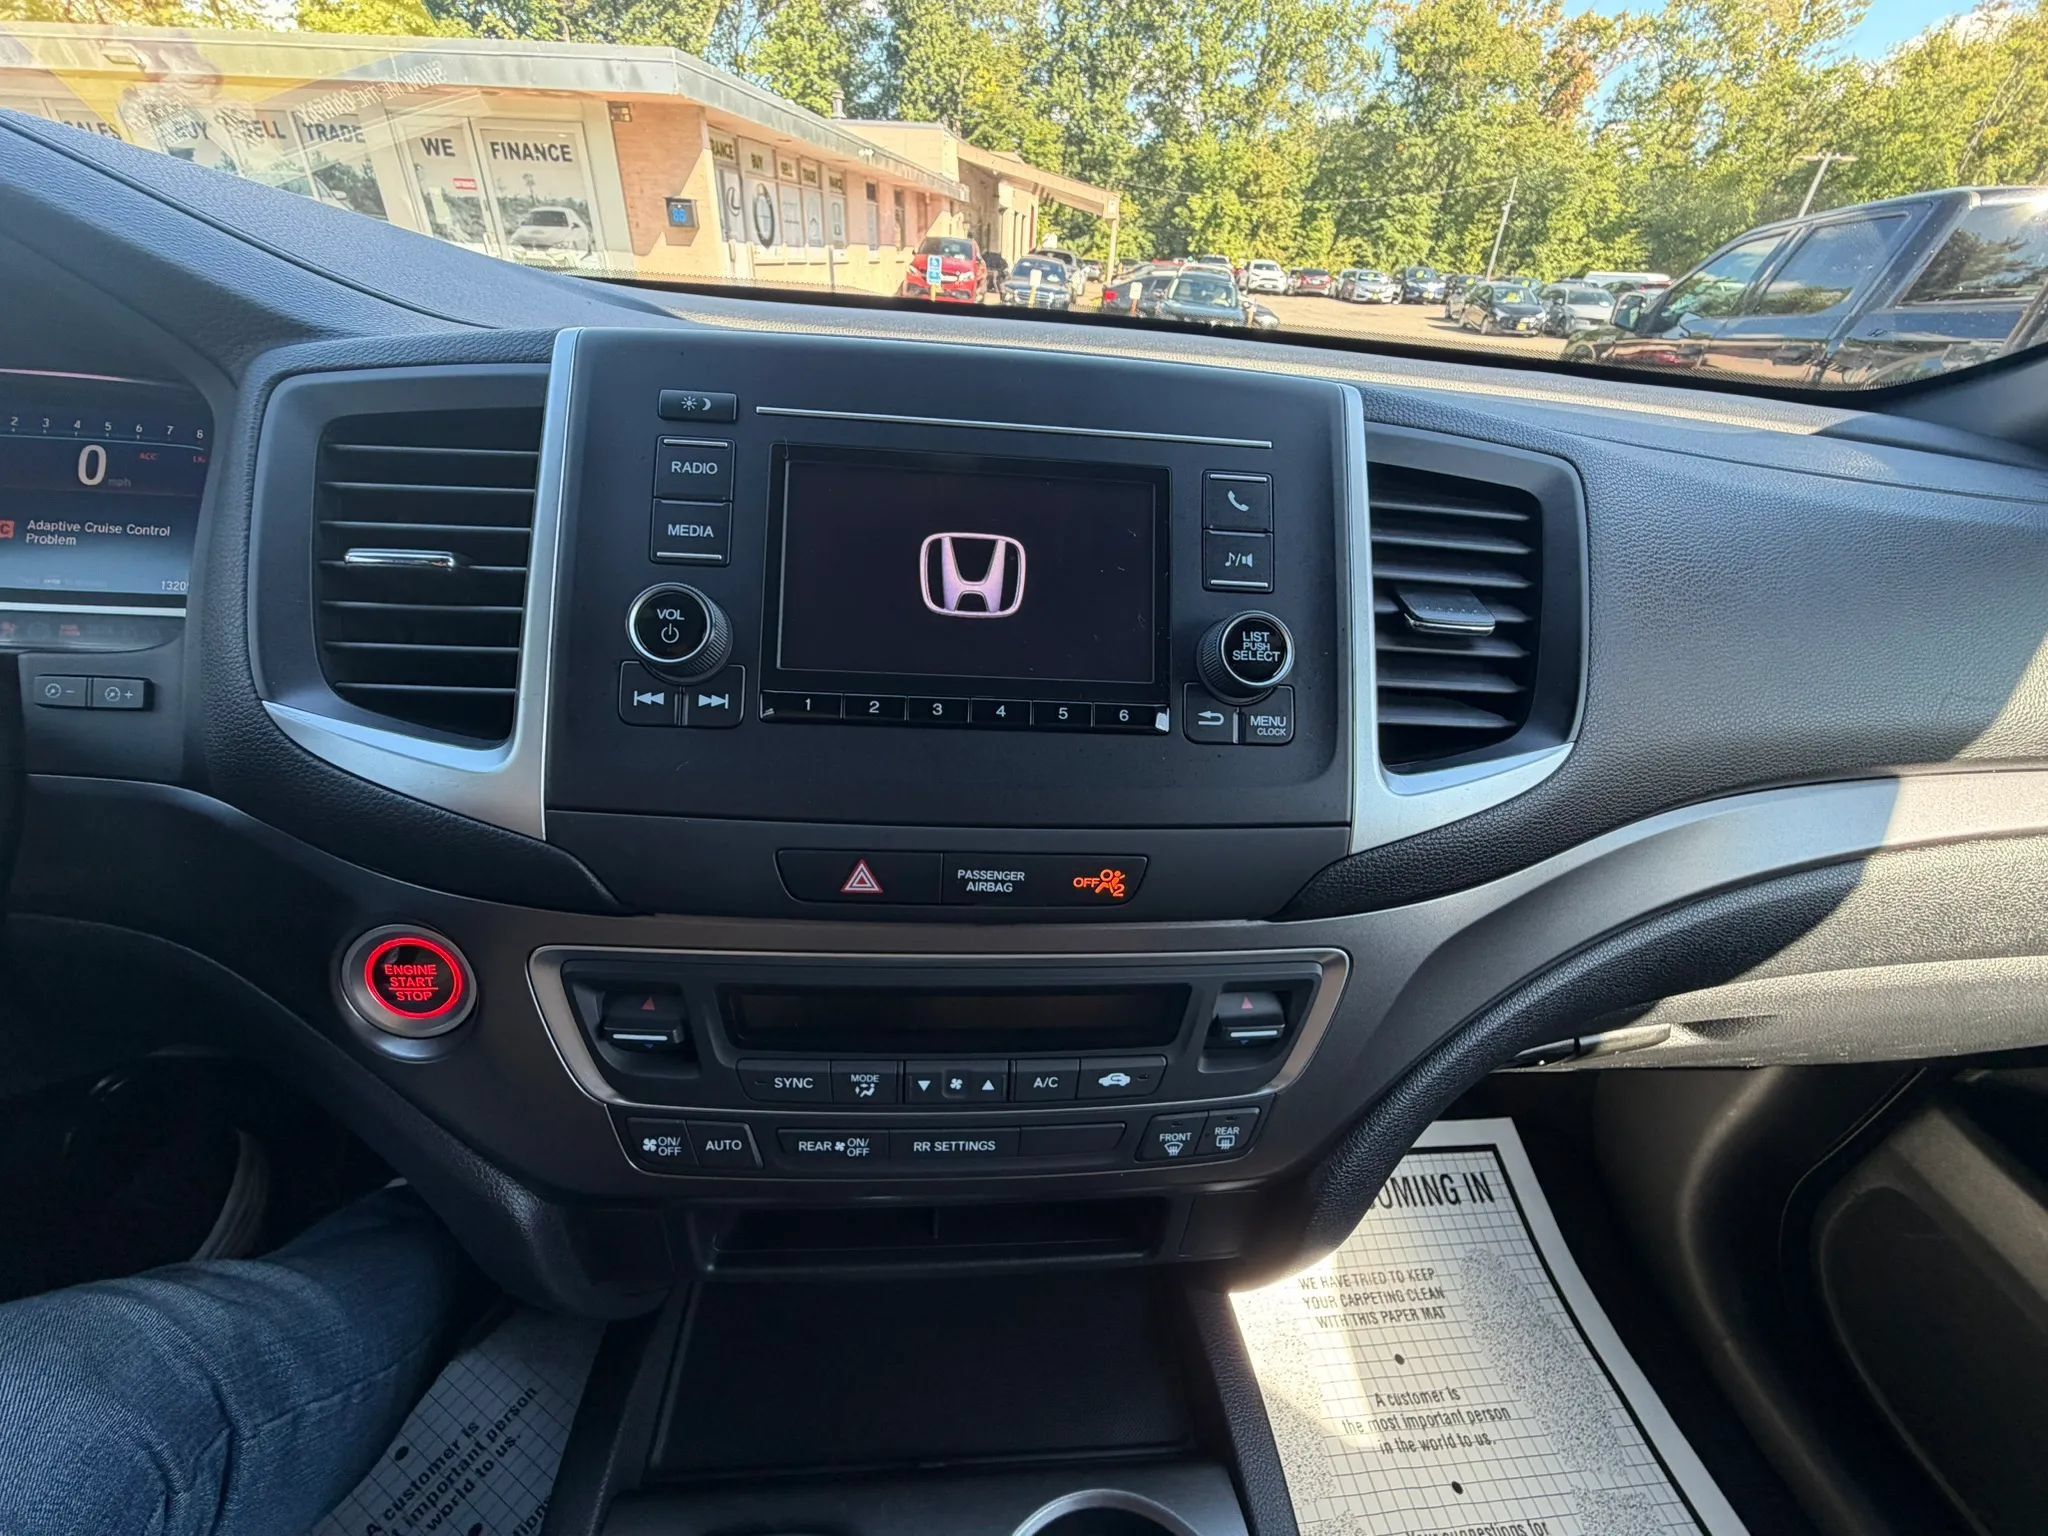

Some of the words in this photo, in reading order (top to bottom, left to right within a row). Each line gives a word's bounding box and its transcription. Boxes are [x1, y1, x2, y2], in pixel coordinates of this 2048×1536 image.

[303, 122, 366, 144] TRADE
[420, 137, 456, 157] WE
[489, 141, 574, 163] FINANCE
[11, 416, 18, 427] 2
[42, 418, 50, 428] 3
[73, 419, 81, 429] 4
[104, 421, 112, 432] 5
[135, 423, 143, 433] 6
[166, 425, 174, 436] 7
[196, 429, 204, 439] 8
[77, 444, 108, 486] 0
[108, 475, 132, 488] mph
[671, 460, 718, 476] RADIO
[27, 519, 81, 534] Adaptive
[85, 522, 122, 535] Cruise
[126, 523, 171, 537] Control
[667, 523, 714, 539] MEDIA
[25, 533, 77, 546] Problem
[160, 580, 189, 592] 1320
[656, 608, 685, 621] VOL
[1242, 631, 1270, 643] LIST
[1243, 642, 1270, 651] PUSH
[1232, 650, 1280, 662] SELECT
[805, 698, 811, 711] 1
[869, 701, 880, 714] 2
[932, 703, 943, 716] 3
[995, 705, 1006, 718] 4
[1058, 707, 1068, 720] 5
[1119, 709, 1129, 722] 6
[1250, 715, 1287, 727] MENU
[1257, 727, 1286, 736] CLOCK
[957, 869, 1025, 882] PASSENGER
[966, 881, 1013, 894] AIRBAG
[1073, 876, 1100, 889] OFF
[384, 963, 438, 976] ENGINE
[389, 977, 434, 987] START
[395, 991, 433, 1001] STOP
[774, 1077, 814, 1089] SYNC
[850, 1074, 880, 1083] MODE
[1033, 1076, 1058, 1089] A/C
[1159, 1131, 1192, 1143] FRONT
[1214, 1126, 1240, 1136] REAR
[658, 1136, 682, 1147] ON/
[705, 1140, 742, 1151] AUTO
[798, 1141, 832, 1151] REAR
[847, 1137, 870, 1148] ON/
[913, 1140, 931, 1152] RR
[934, 1141, 996, 1152] SETTINGS
[658, 1146, 682, 1157] OFF
[847, 1147, 870, 1158] OFF
[1370, 1172, 1462, 1210] OMING
[1462, 1171, 1496, 1204] IN
[1298, 1277, 1318, 1290] WE
[1319, 1274, 1351, 1289] HAVE
[1351, 1271, 1387, 1287] TRIED
[1388, 1269, 1406, 1284] TO
[1406, 1267, 1435, 1282] KEEP
[1302, 1294, 1339, 1310] YOUR
[1339, 1289, 1405, 1308] CARPETING
[1406, 1286, 1446, 1302] CLEAN
[1316, 1313, 1349, 1329] WITH
[1350, 1311, 1379, 1327] THIS
[1380, 1308, 1420, 1324] PAPER
[1420, 1305, 1447, 1320] MAT
[1374, 1393, 1385, 1408] A
[1386, 1390, 1445, 1408] customer
[1446, 1386, 1461, 1401] is
[1342, 1418, 1364, 1435] the
[1369, 1413, 1401, 1432] most
[1402, 1408, 1466, 1432] important
[1466, 1406, 1511, 1426] person
[1378, 1439, 1394, 1455] in
[1395, 1436, 1417, 1453] the
[1418, 1433, 1457, 1452] world
[1457, 1431, 1473, 1447] to
[1475, 1432, 1497, 1446] us.
[406, 1441, 488, 1528] important
[486, 1386, 538, 1443] person
[383, 1438, 461, 1522] customer
[461, 1420, 480, 1438] is
[426, 1477, 476, 1532] world
[475, 1457, 495, 1479] to
[496, 1433, 523, 1458] us.
[1527, 1519, 1550, 1536] for
